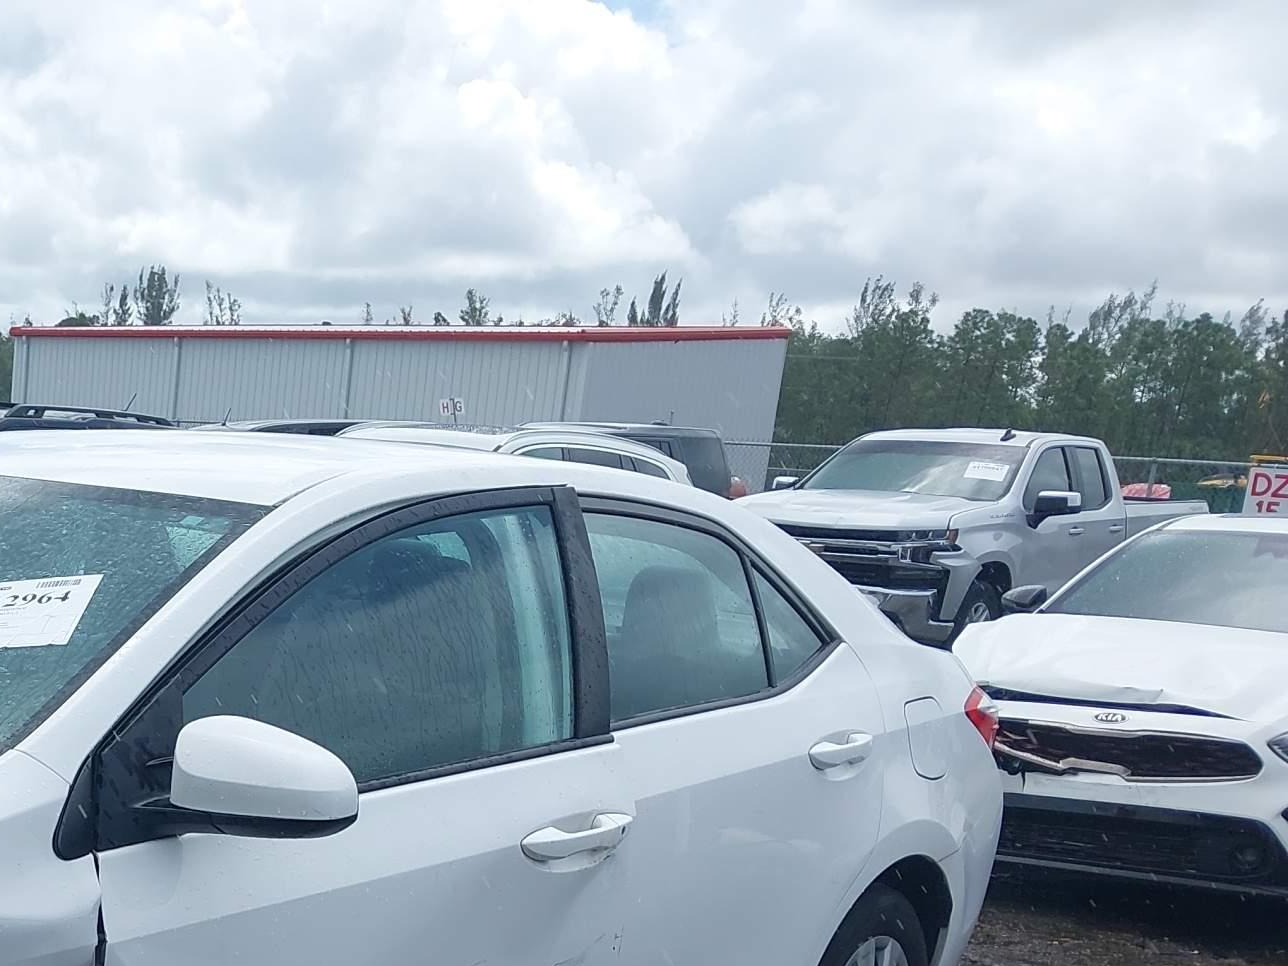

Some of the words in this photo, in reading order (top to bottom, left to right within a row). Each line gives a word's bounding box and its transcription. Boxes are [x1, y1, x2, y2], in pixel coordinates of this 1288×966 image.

[442, 402, 450, 414] H
[455, 401, 463, 413] G
[1251, 472, 1288, 498] DZ
[1097, 713, 1122, 721] KIA
